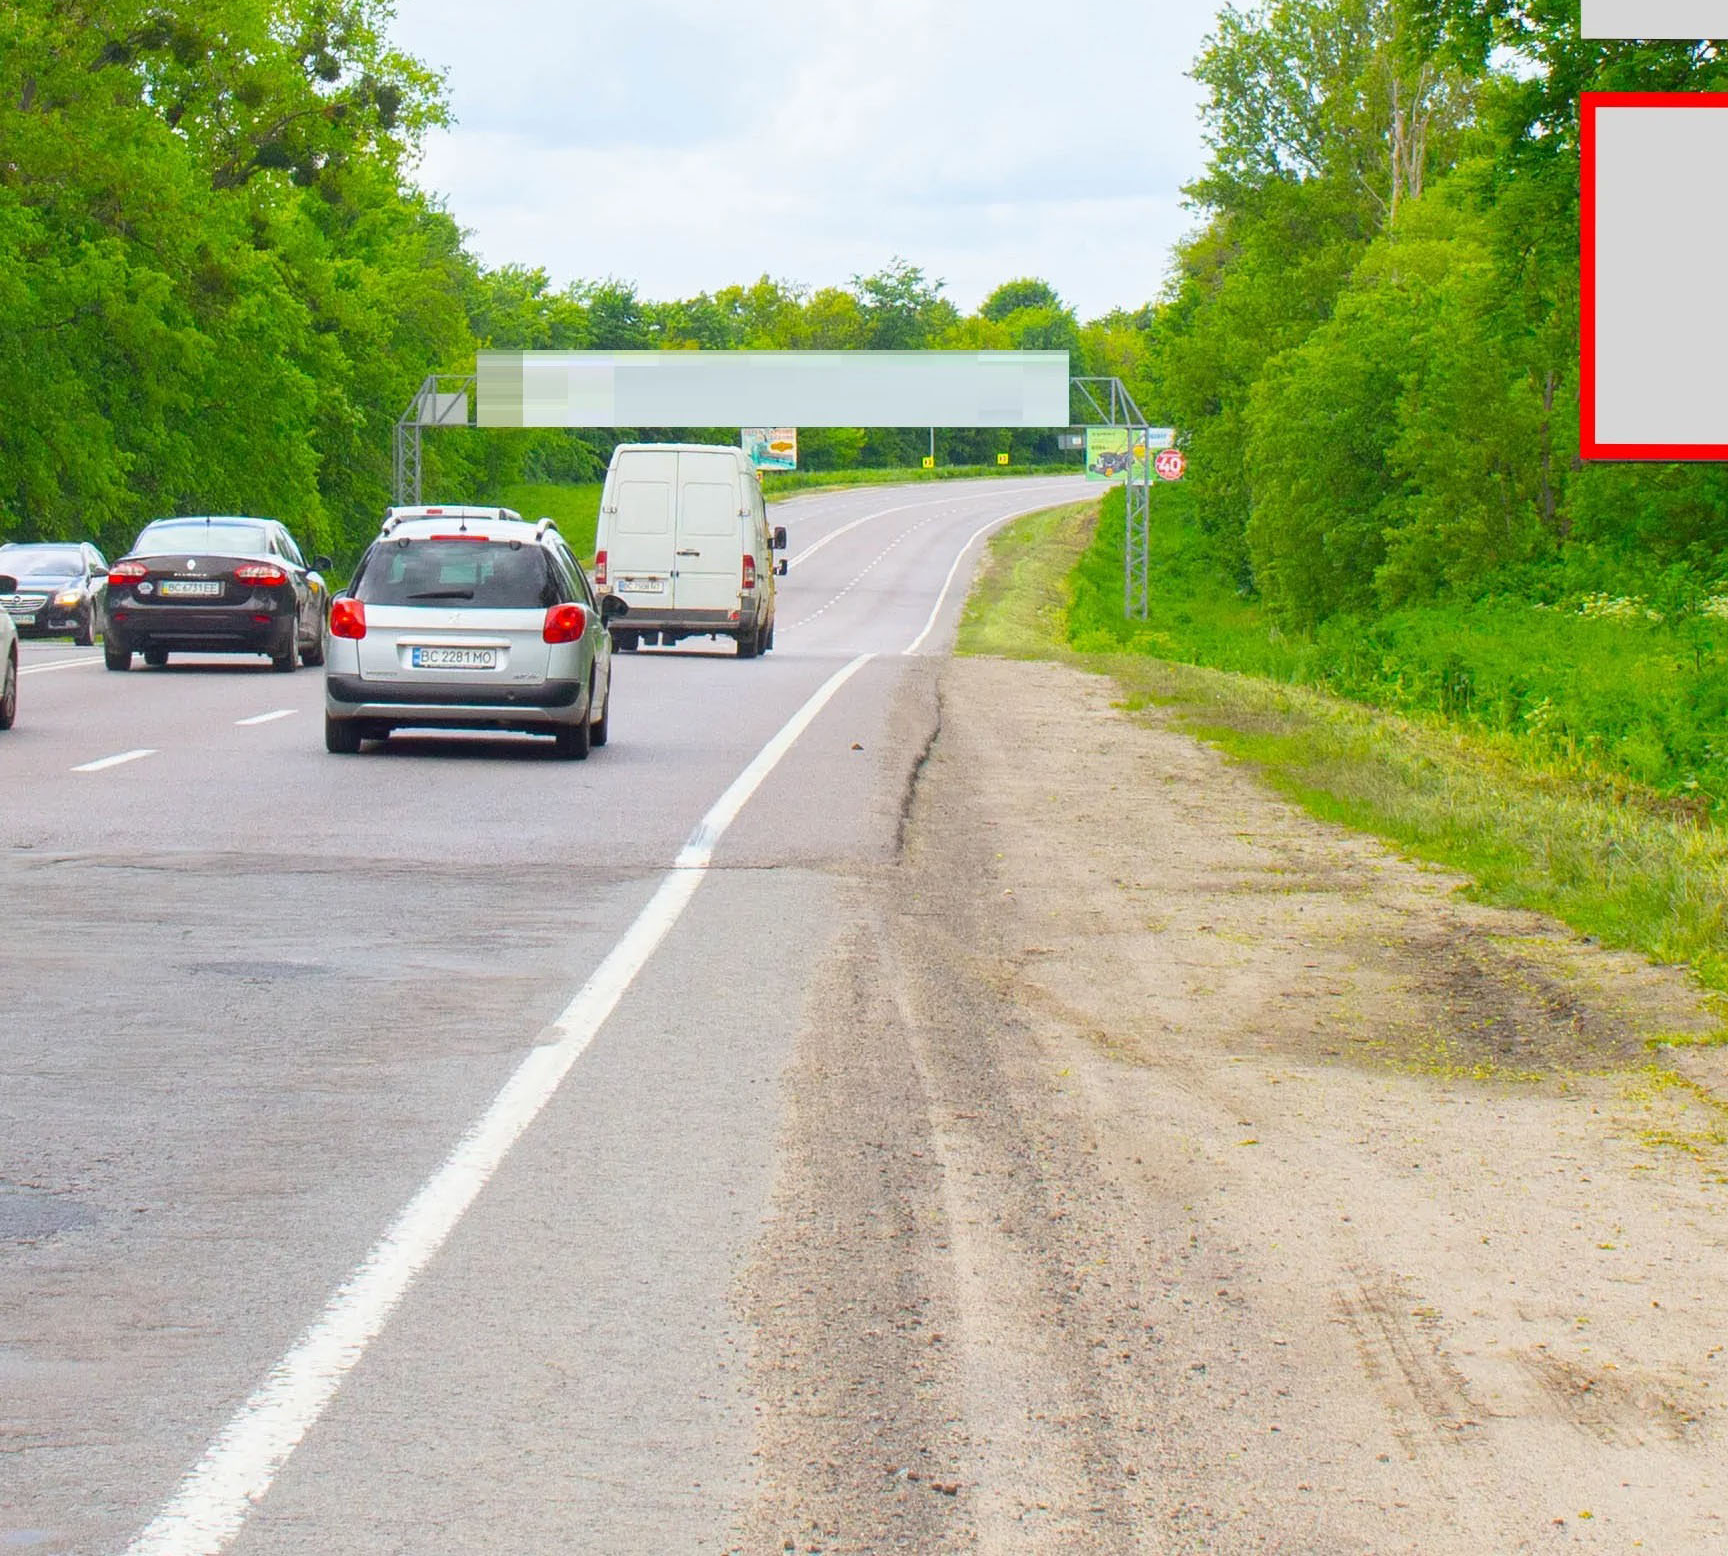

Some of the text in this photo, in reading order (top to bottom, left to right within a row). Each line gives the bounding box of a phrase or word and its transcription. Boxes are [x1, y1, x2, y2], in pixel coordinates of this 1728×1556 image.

[1158, 456, 1182, 471] 40
[422, 650, 492, 664] BC 2281 MO
